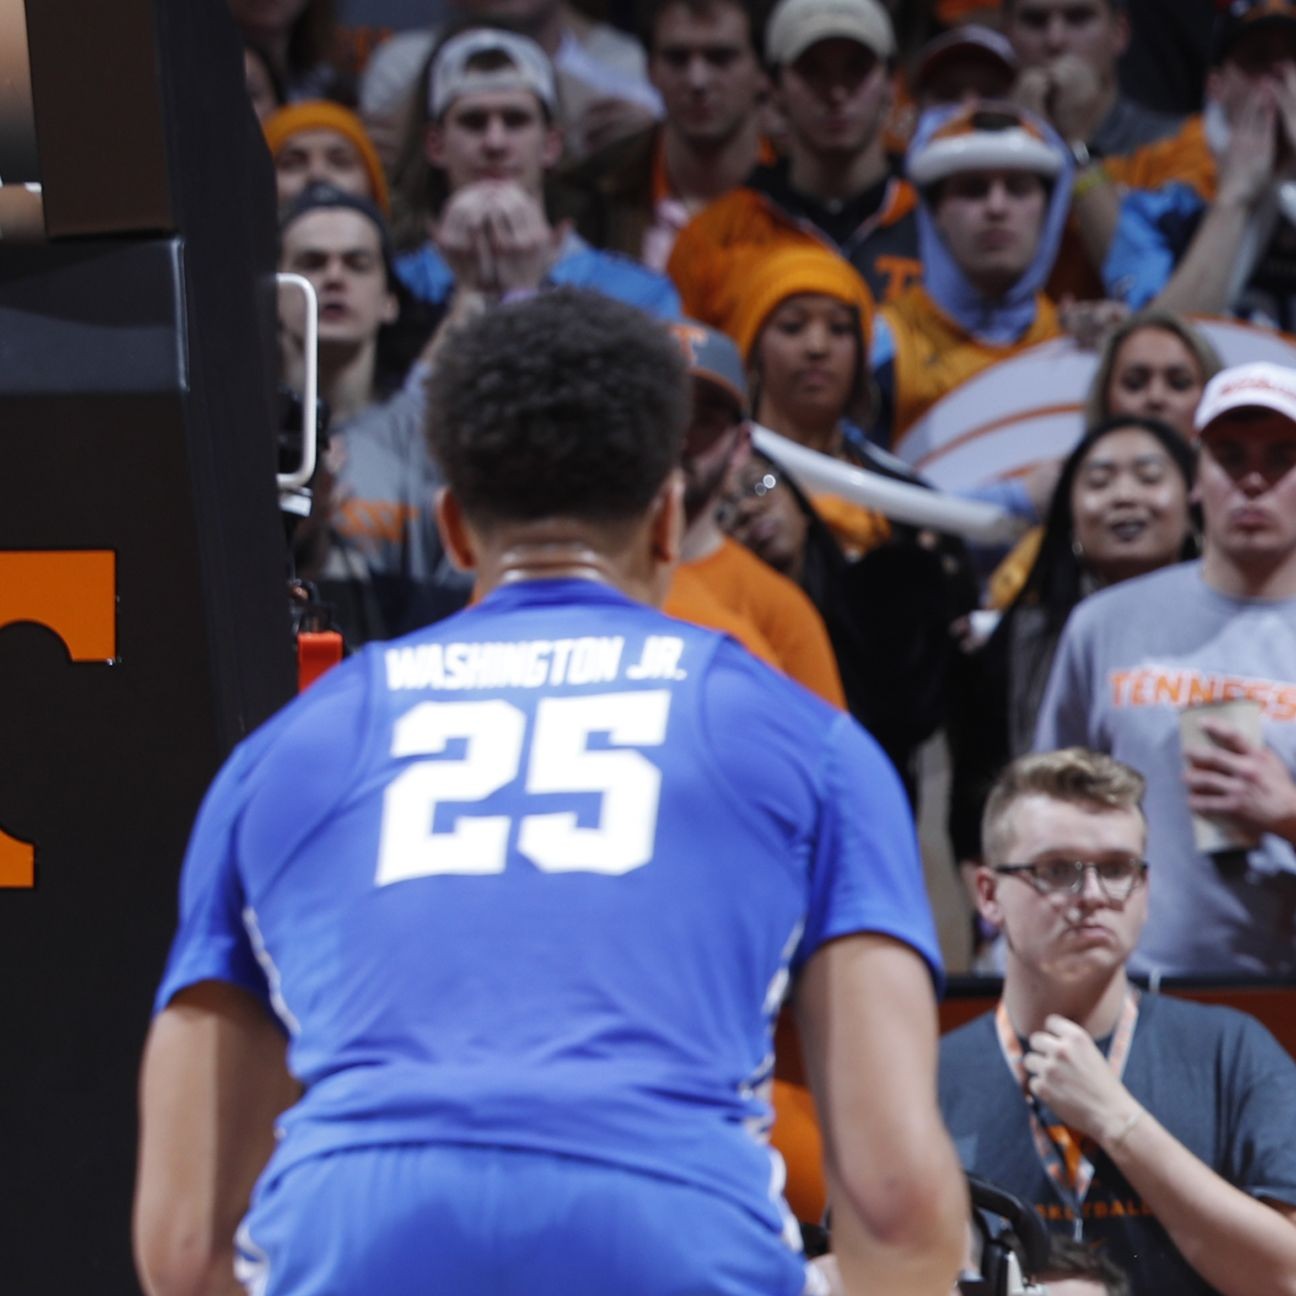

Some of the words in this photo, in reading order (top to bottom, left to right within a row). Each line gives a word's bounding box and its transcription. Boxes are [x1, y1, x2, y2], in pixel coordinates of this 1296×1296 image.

[384, 636, 624, 690] WASHINGTON
[626, 634, 688, 681] JR.
[373, 689, 672, 888] 25
